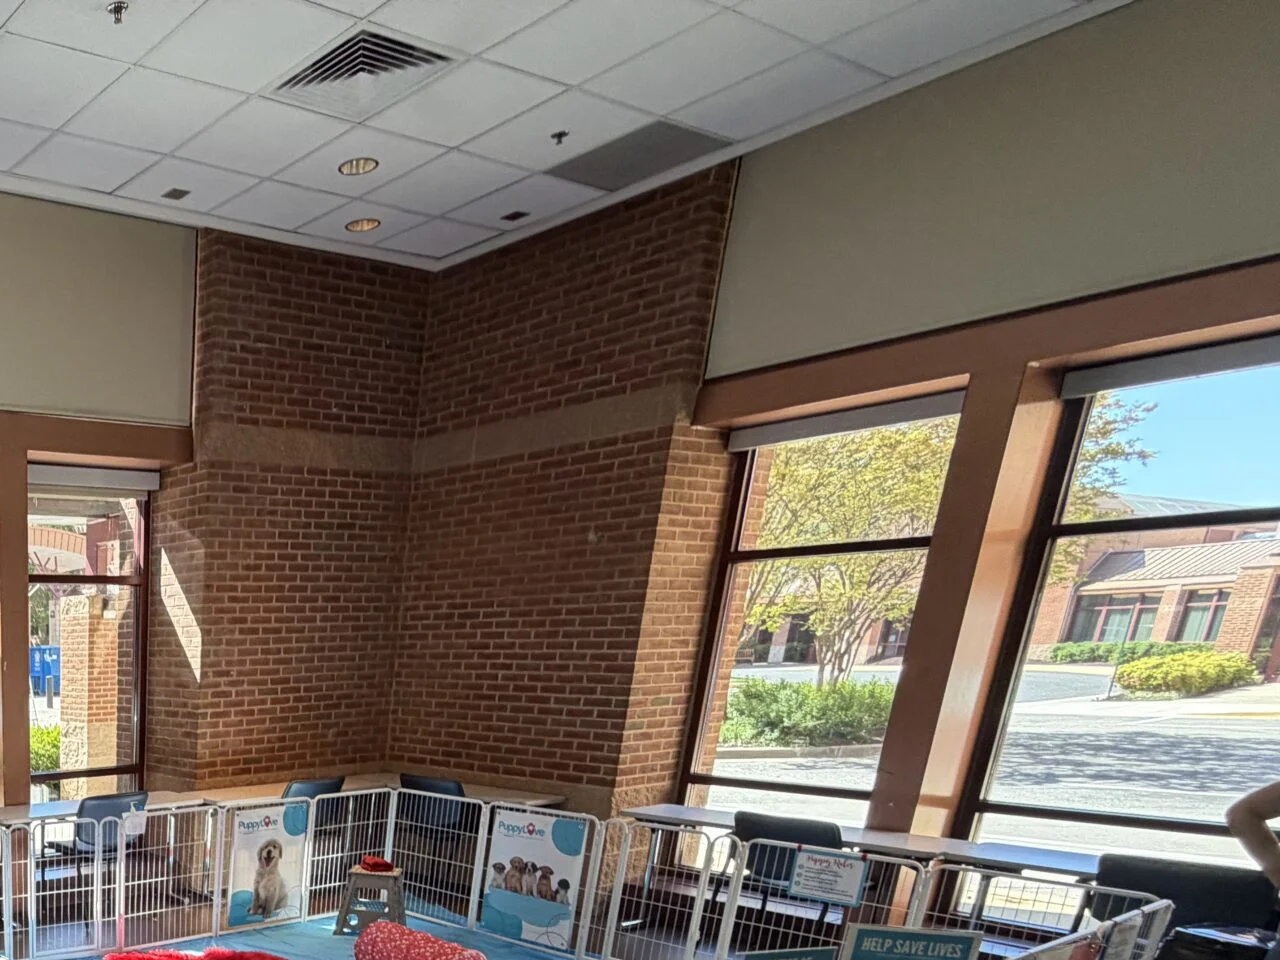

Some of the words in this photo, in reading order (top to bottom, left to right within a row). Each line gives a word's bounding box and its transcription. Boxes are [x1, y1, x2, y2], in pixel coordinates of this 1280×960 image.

[861, 936, 893, 952] HELP
[893, 939, 928, 955] SAVE
[927, 942, 963, 958] LIVES
